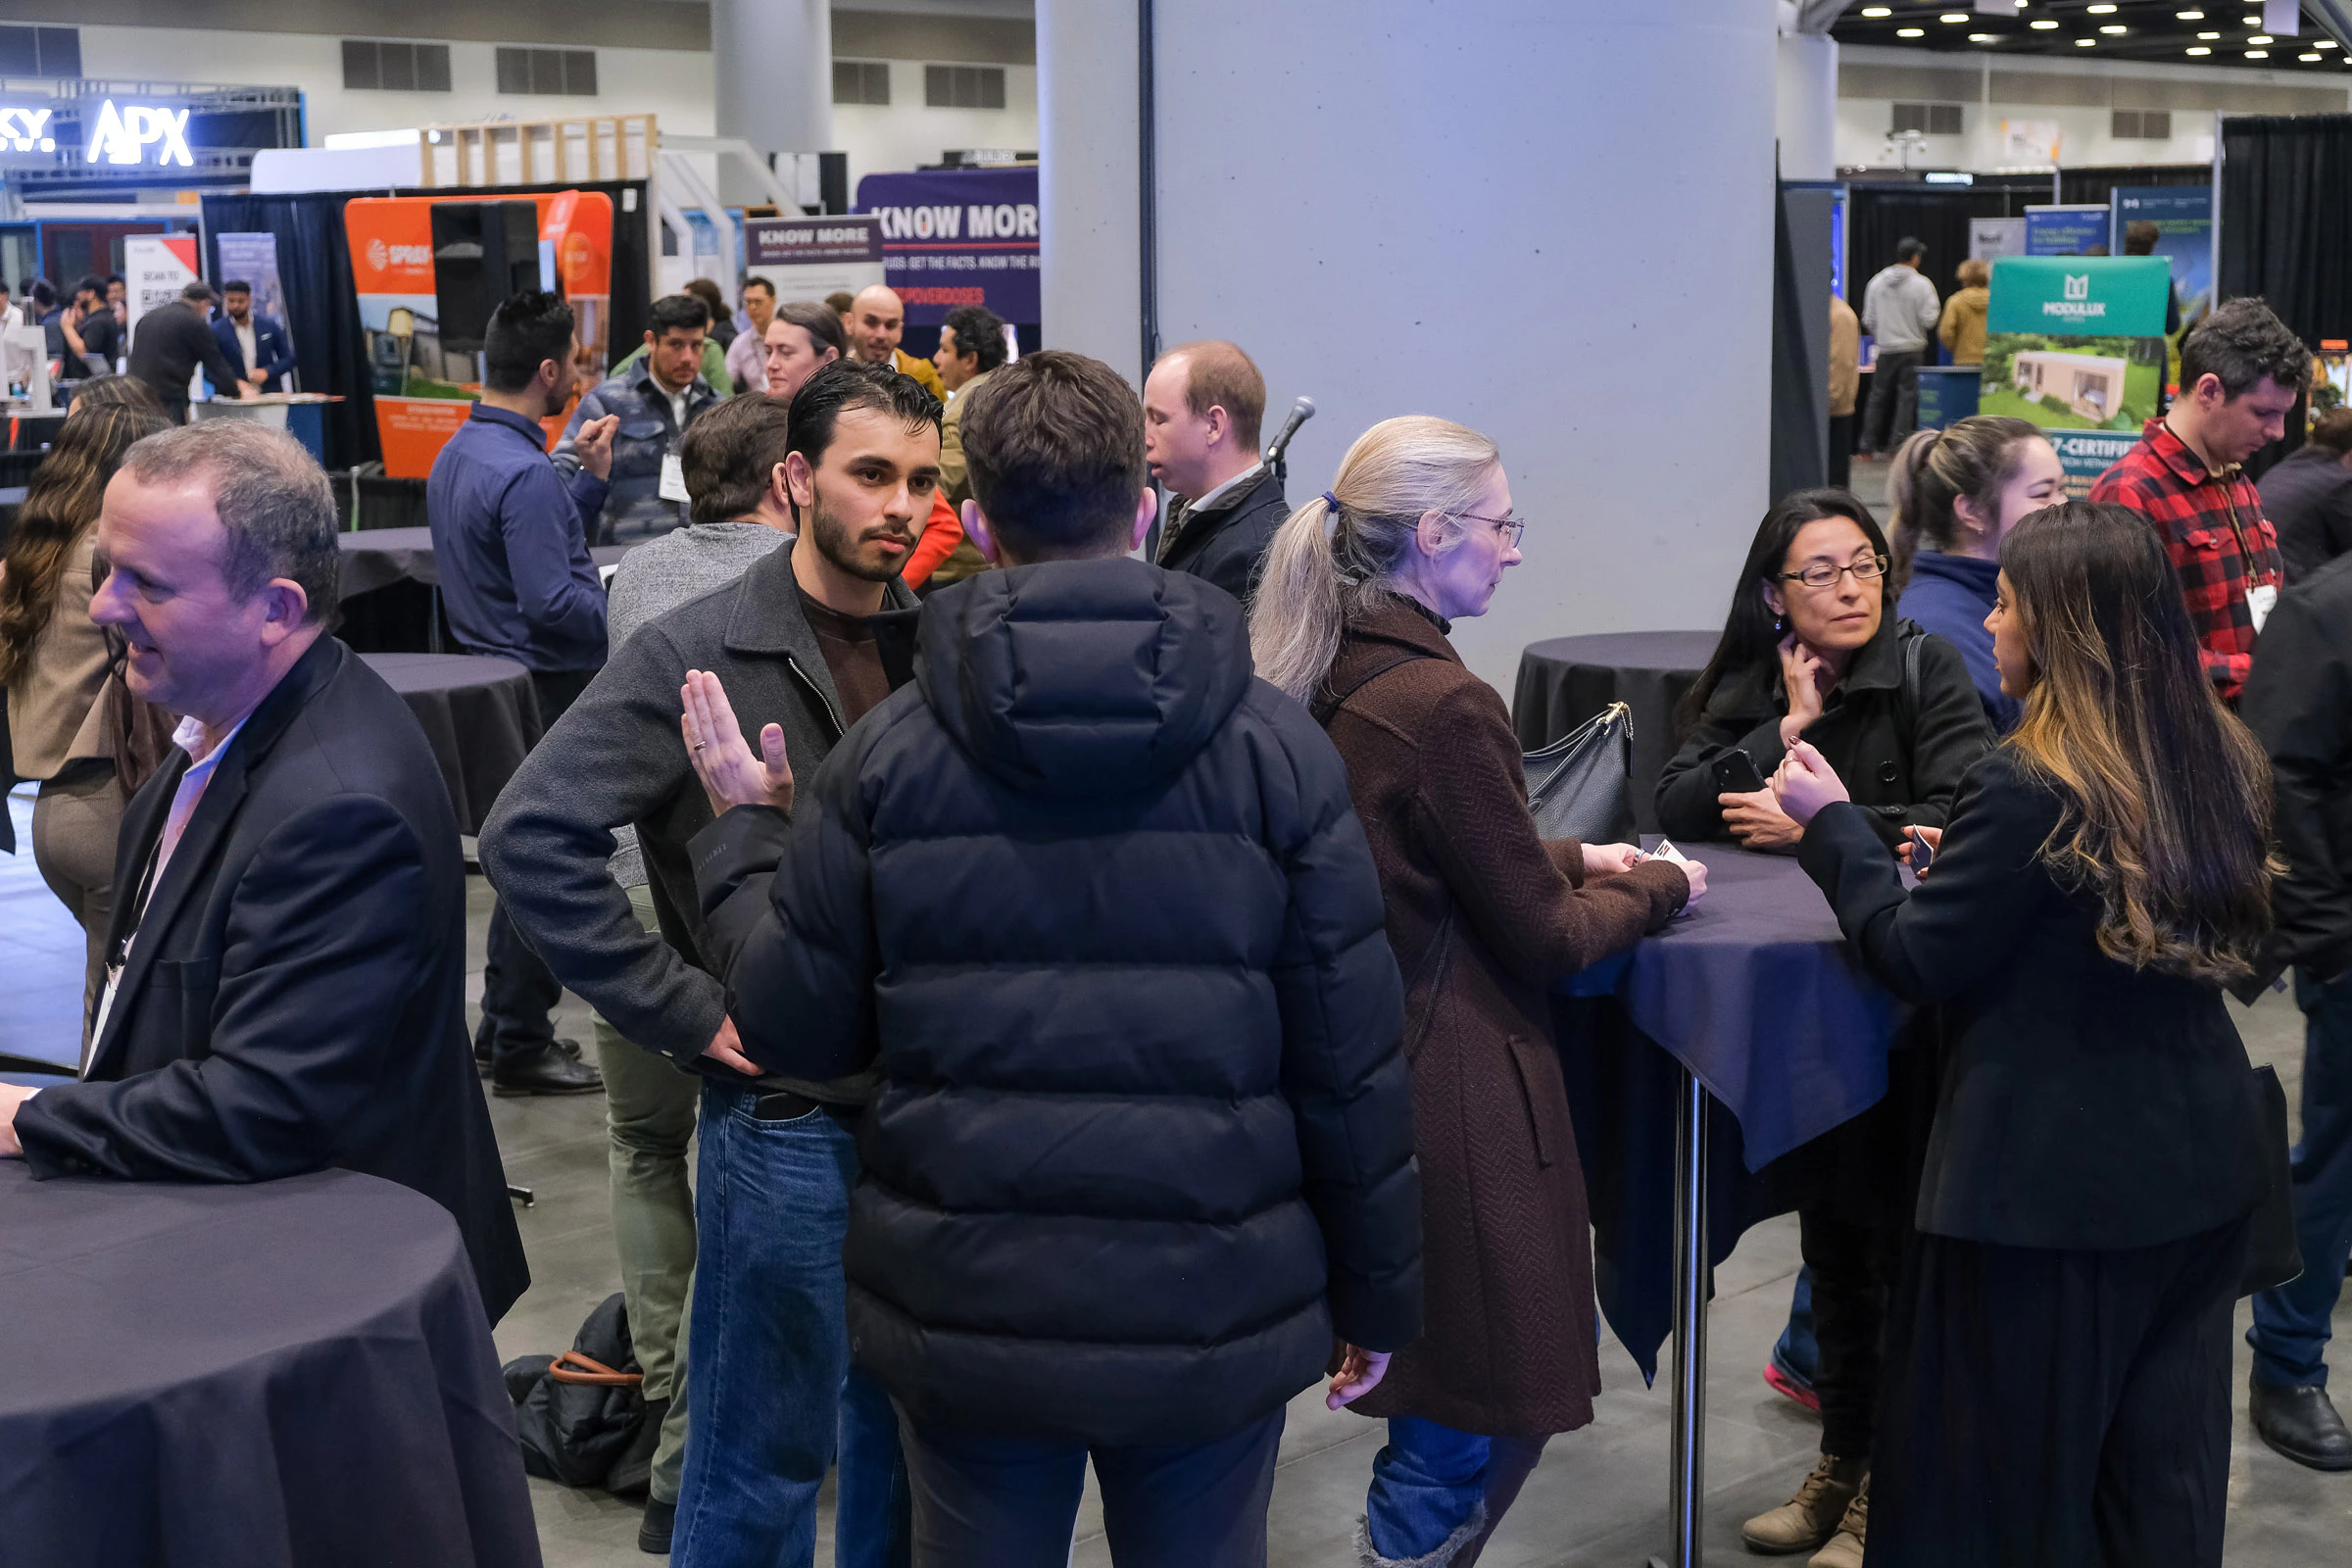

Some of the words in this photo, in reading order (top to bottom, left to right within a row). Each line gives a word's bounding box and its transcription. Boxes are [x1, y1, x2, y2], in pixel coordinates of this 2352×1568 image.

[87, 99, 194, 167] APX
[759, 228, 814, 245] KNOW
[817, 227, 869, 244] MORE
[871, 206, 962, 239] KNOW
[967, 204, 1039, 238] MOR
